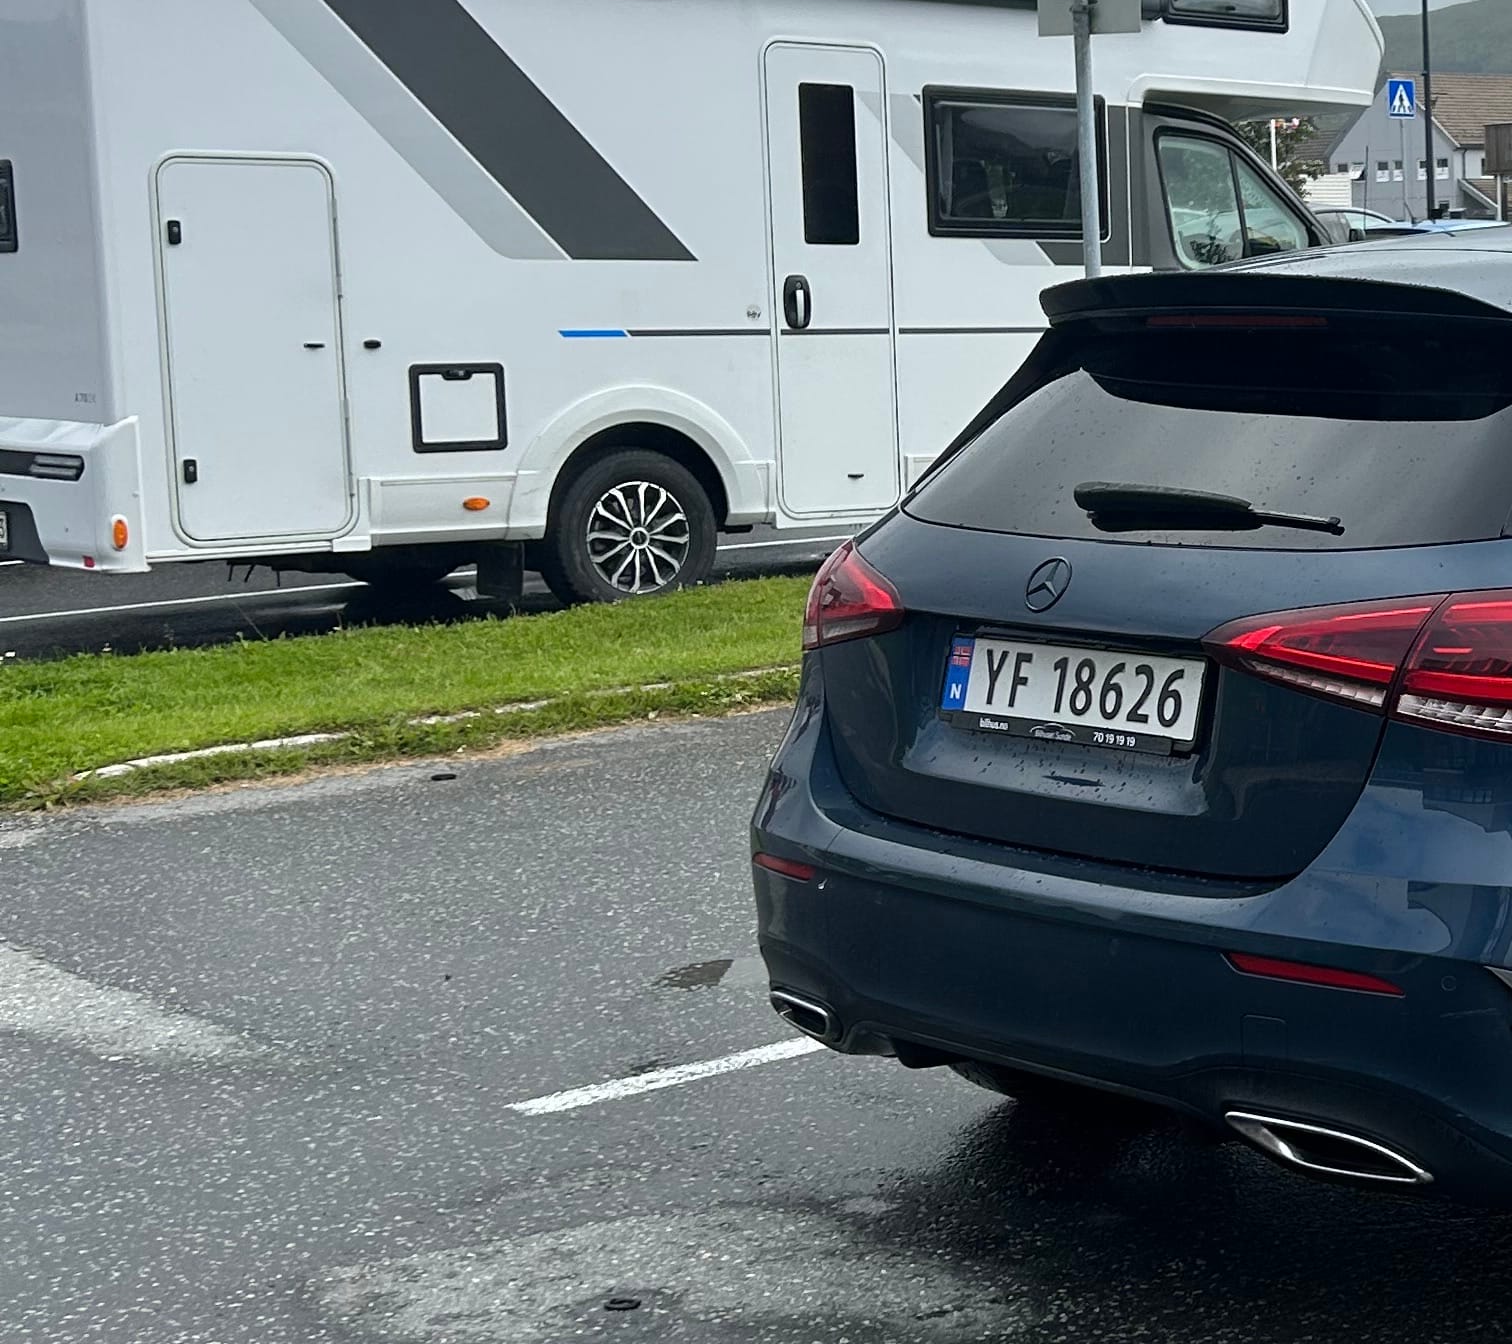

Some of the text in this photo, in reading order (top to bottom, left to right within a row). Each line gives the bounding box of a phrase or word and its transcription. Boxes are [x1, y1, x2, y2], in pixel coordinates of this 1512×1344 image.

[950, 683, 962, 700] N
[986, 648, 1185, 728] YF 18626
[1093, 731, 1136, 747] 70 19 19 19
